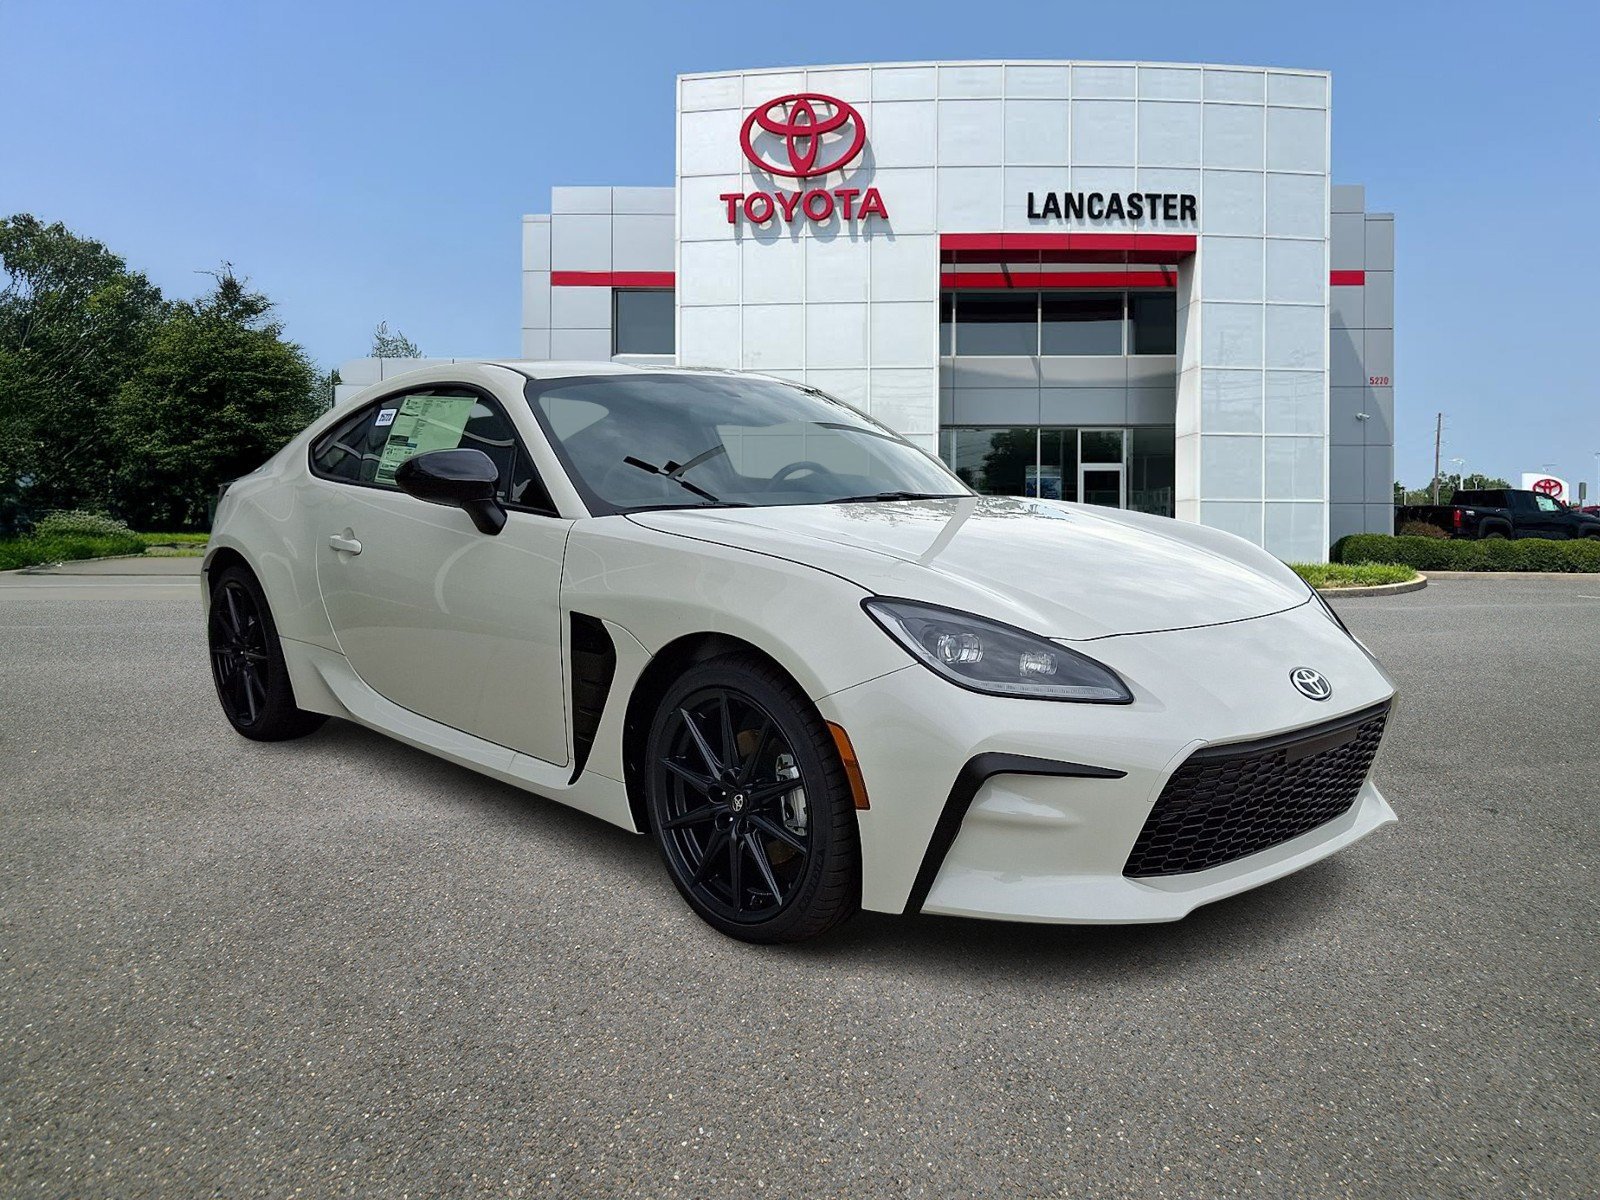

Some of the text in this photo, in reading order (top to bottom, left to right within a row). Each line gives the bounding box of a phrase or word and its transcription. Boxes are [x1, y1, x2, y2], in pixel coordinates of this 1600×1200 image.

[720, 188, 889, 224] TOYOTA
[1027, 192, 1197, 221] LANCASTER
[1369, 376, 1389, 385] 5270
